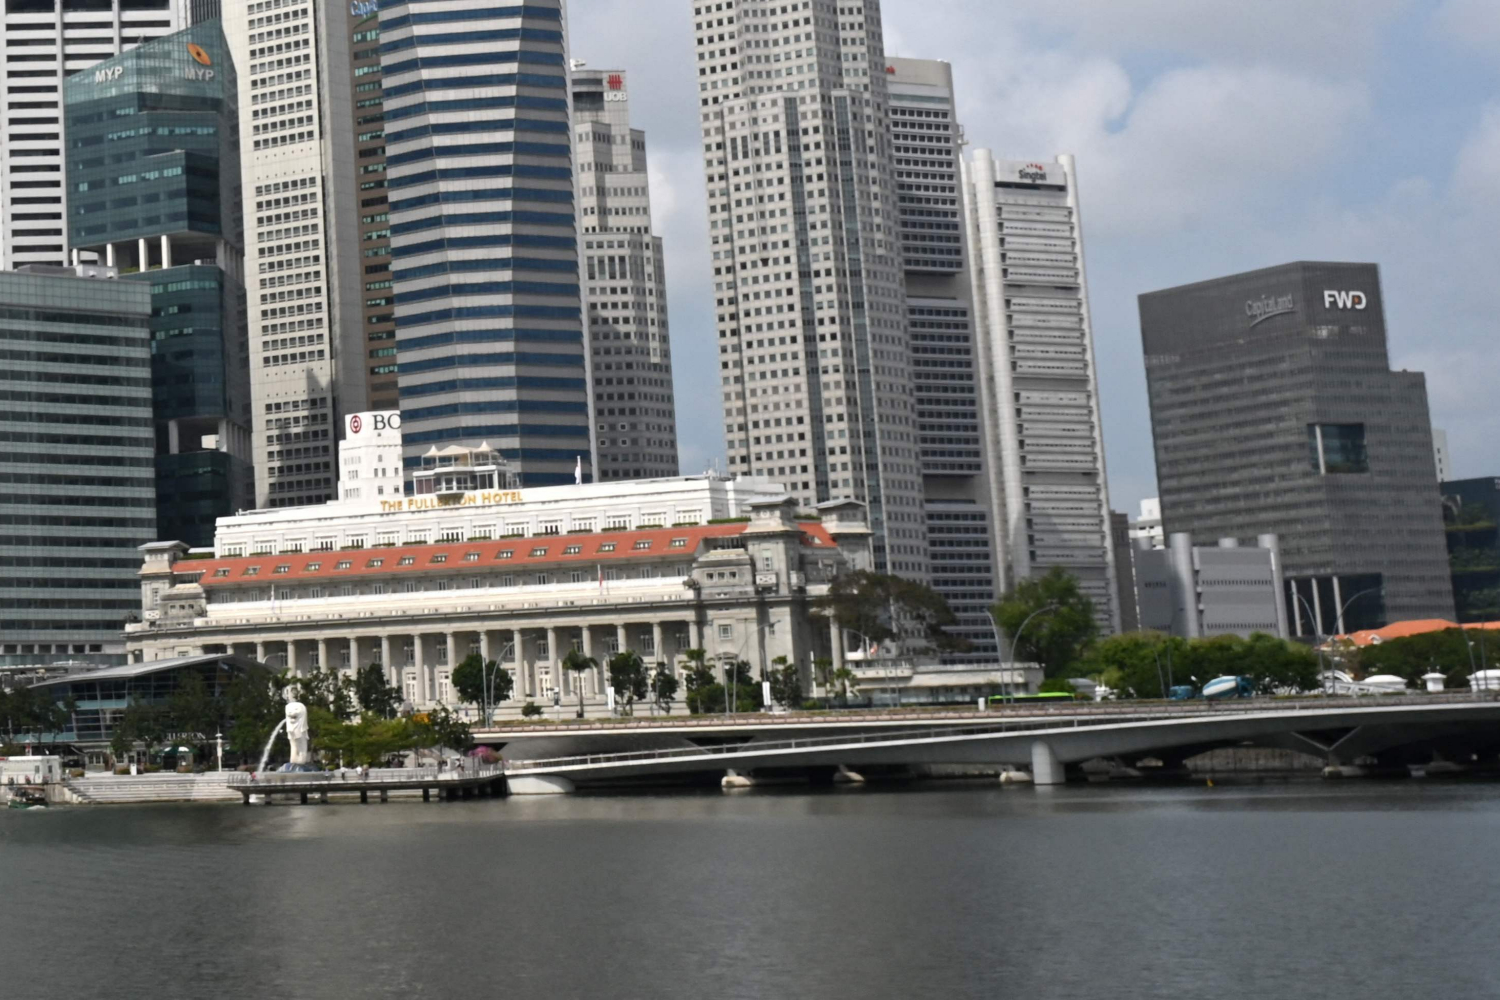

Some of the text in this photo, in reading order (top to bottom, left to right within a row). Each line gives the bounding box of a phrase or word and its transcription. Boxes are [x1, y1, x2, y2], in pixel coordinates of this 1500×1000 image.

[95, 66, 124, 84] MYP
[184, 68, 214, 81] MYP
[604, 92, 627, 101] UOB
[1018, 168, 1047, 184] Singtel
[1245, 294, 1294, 318] CapitaLand
[1323, 290, 1367, 310] FWD
[380, 500, 403, 511] THE
[481, 491, 523, 503] HOTEL
